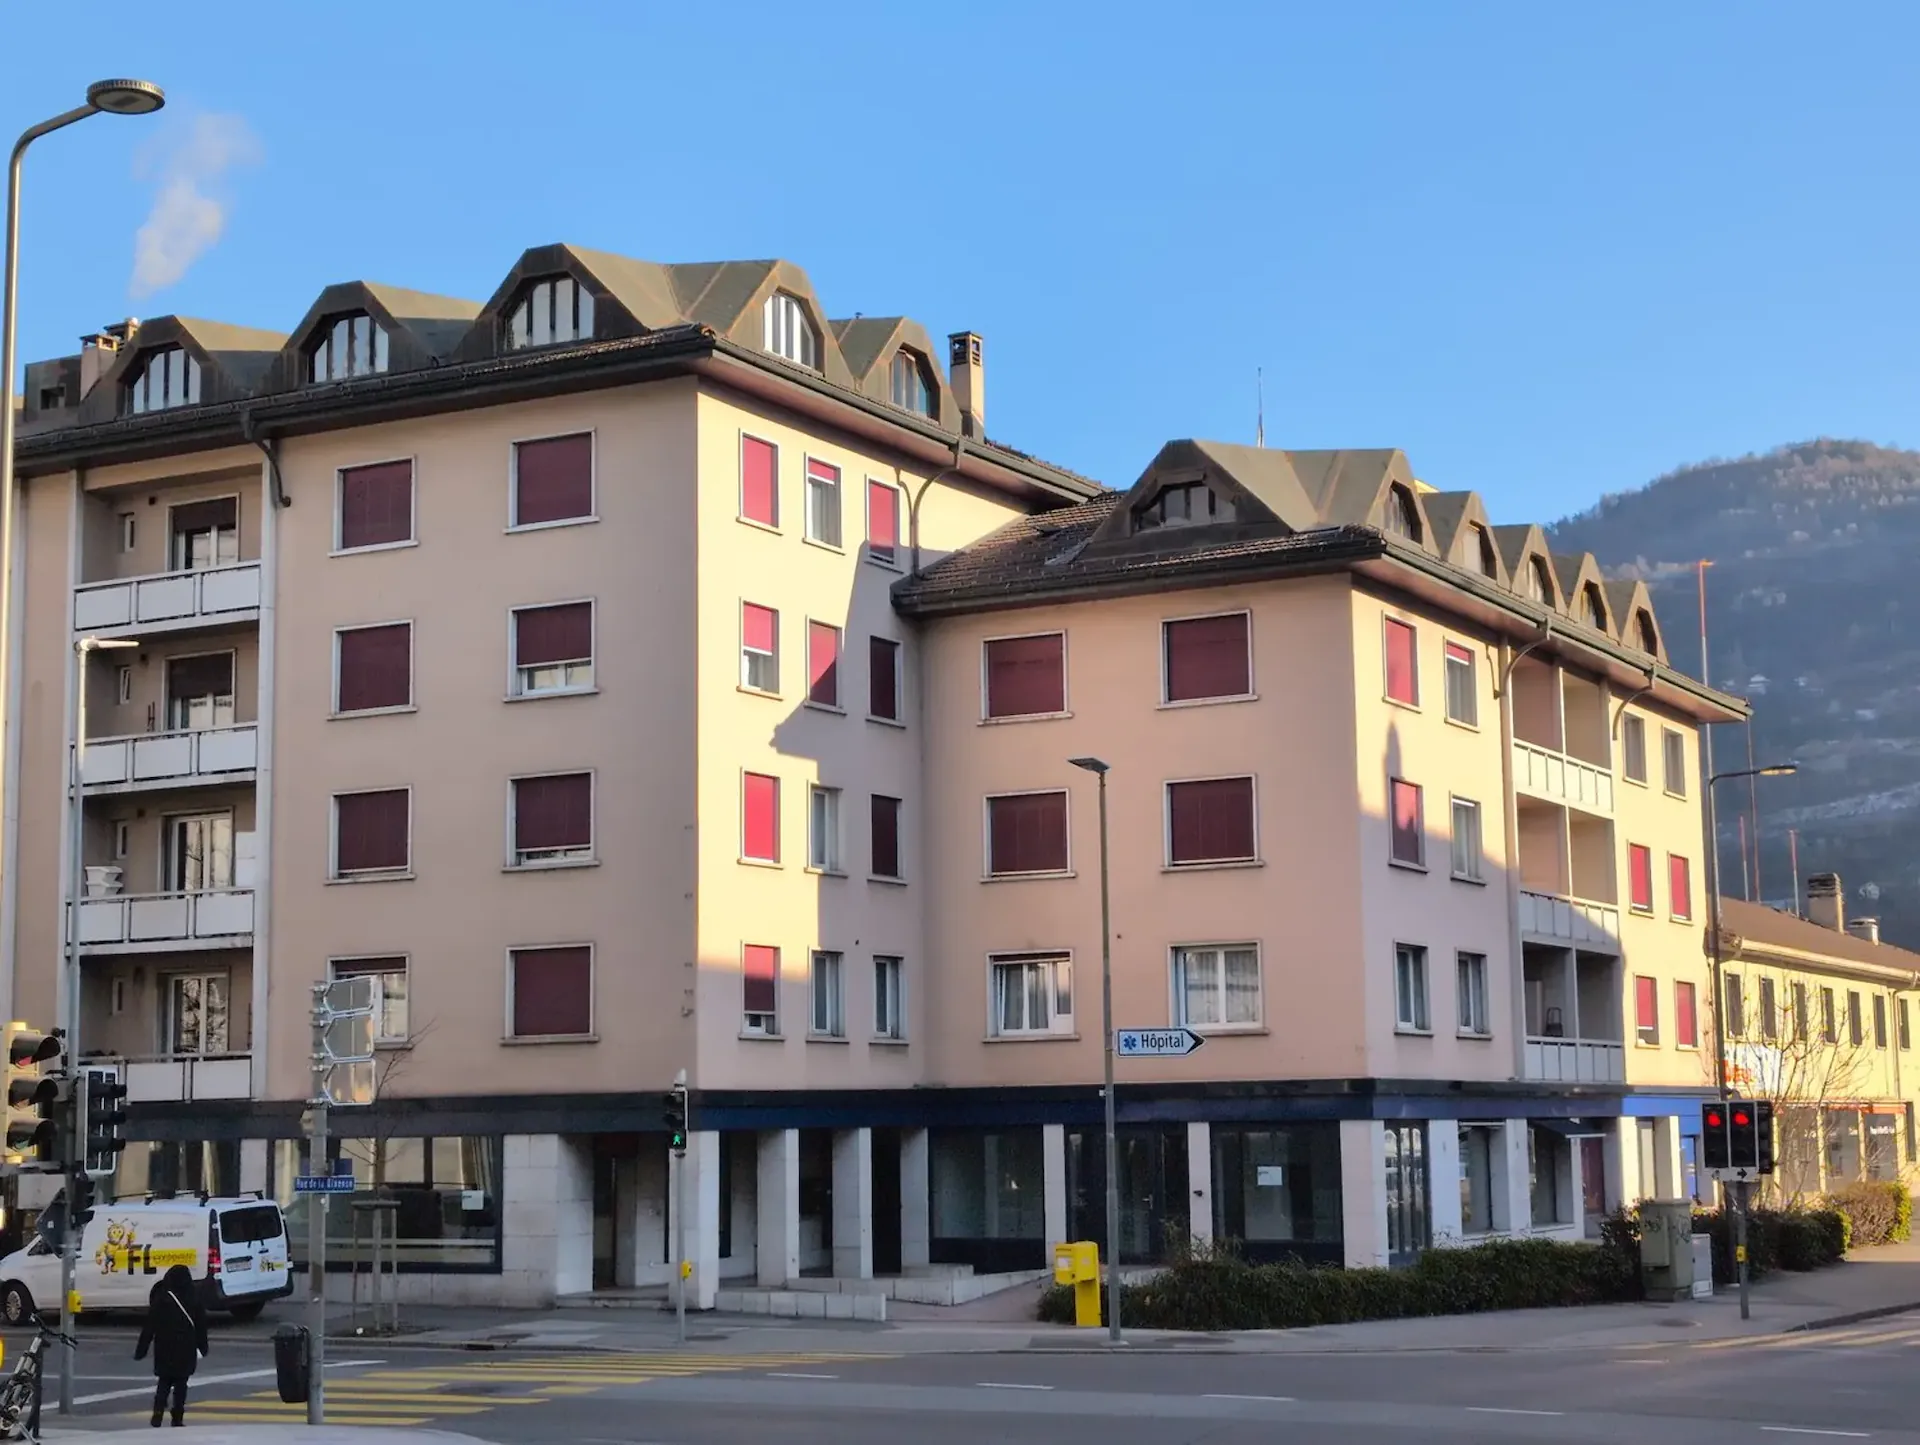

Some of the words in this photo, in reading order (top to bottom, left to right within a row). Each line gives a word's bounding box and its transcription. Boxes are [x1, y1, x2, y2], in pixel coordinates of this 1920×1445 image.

[1141, 1032, 1184, 1052] Hôpital
[296, 1178, 308, 1188] Rue
[309, 1178, 317, 1188] de
[127, 1244, 157, 1275] FL
